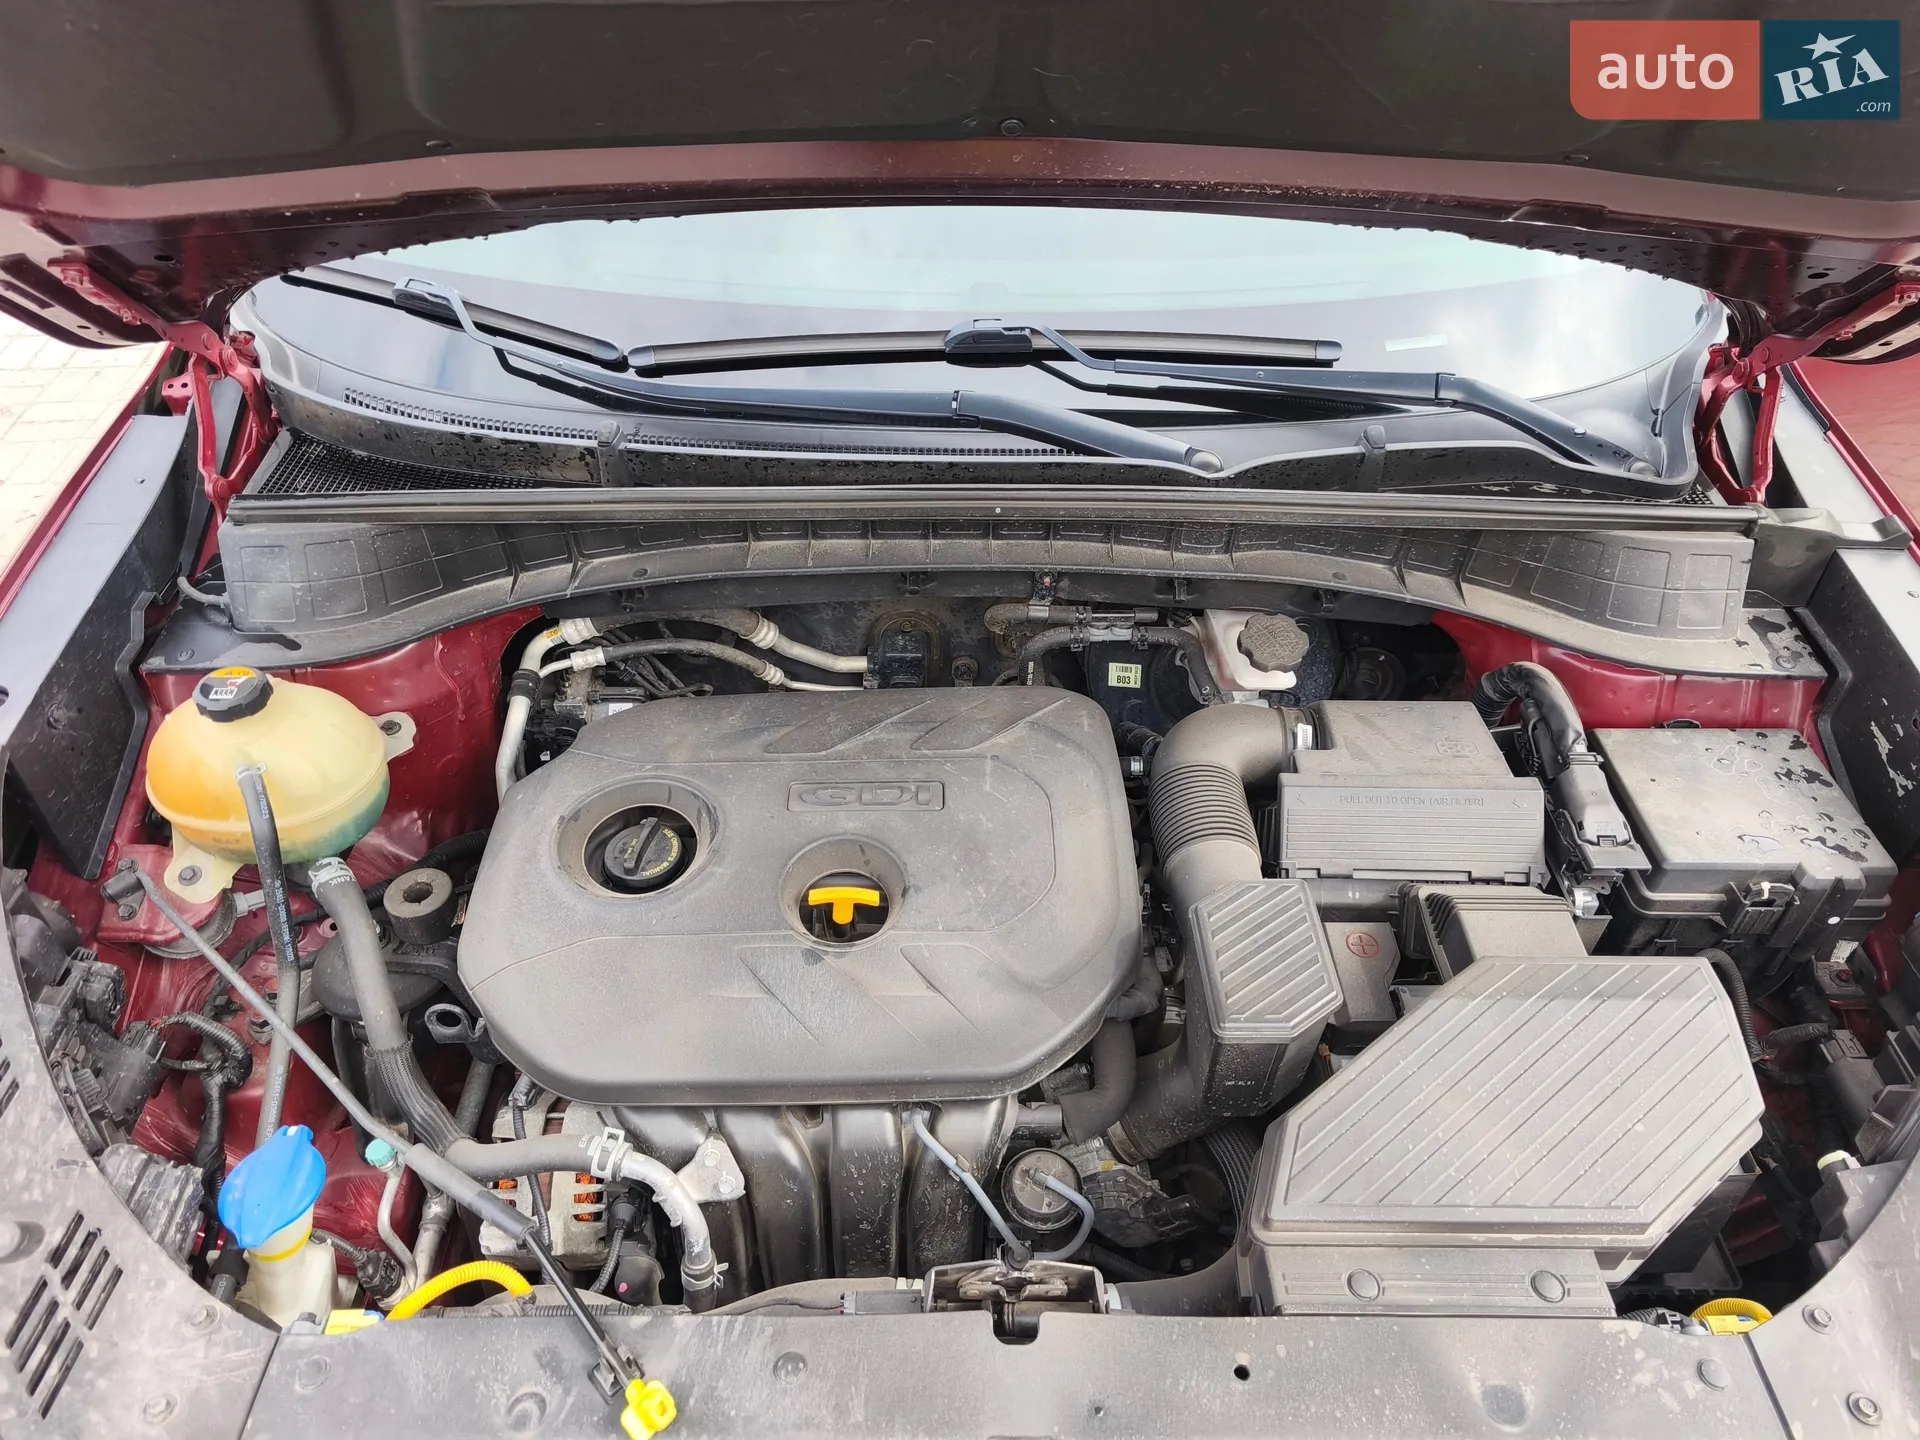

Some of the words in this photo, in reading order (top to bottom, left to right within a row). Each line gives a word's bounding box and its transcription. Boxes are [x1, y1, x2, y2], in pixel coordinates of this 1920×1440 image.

[1116, 675, 1131, 684] B03
[799, 785, 930, 807] GDI
[1339, 794, 1361, 804] PULL
[1365, 795, 1383, 804] OUT
[1386, 796, 1398, 804] TO
[1401, 796, 1425, 805] OPEN
[662, 828, 674, 838] SEE
[640, 862, 669, 876] MANUAL
[268, 1076, 282, 1123] 25451-D3000
